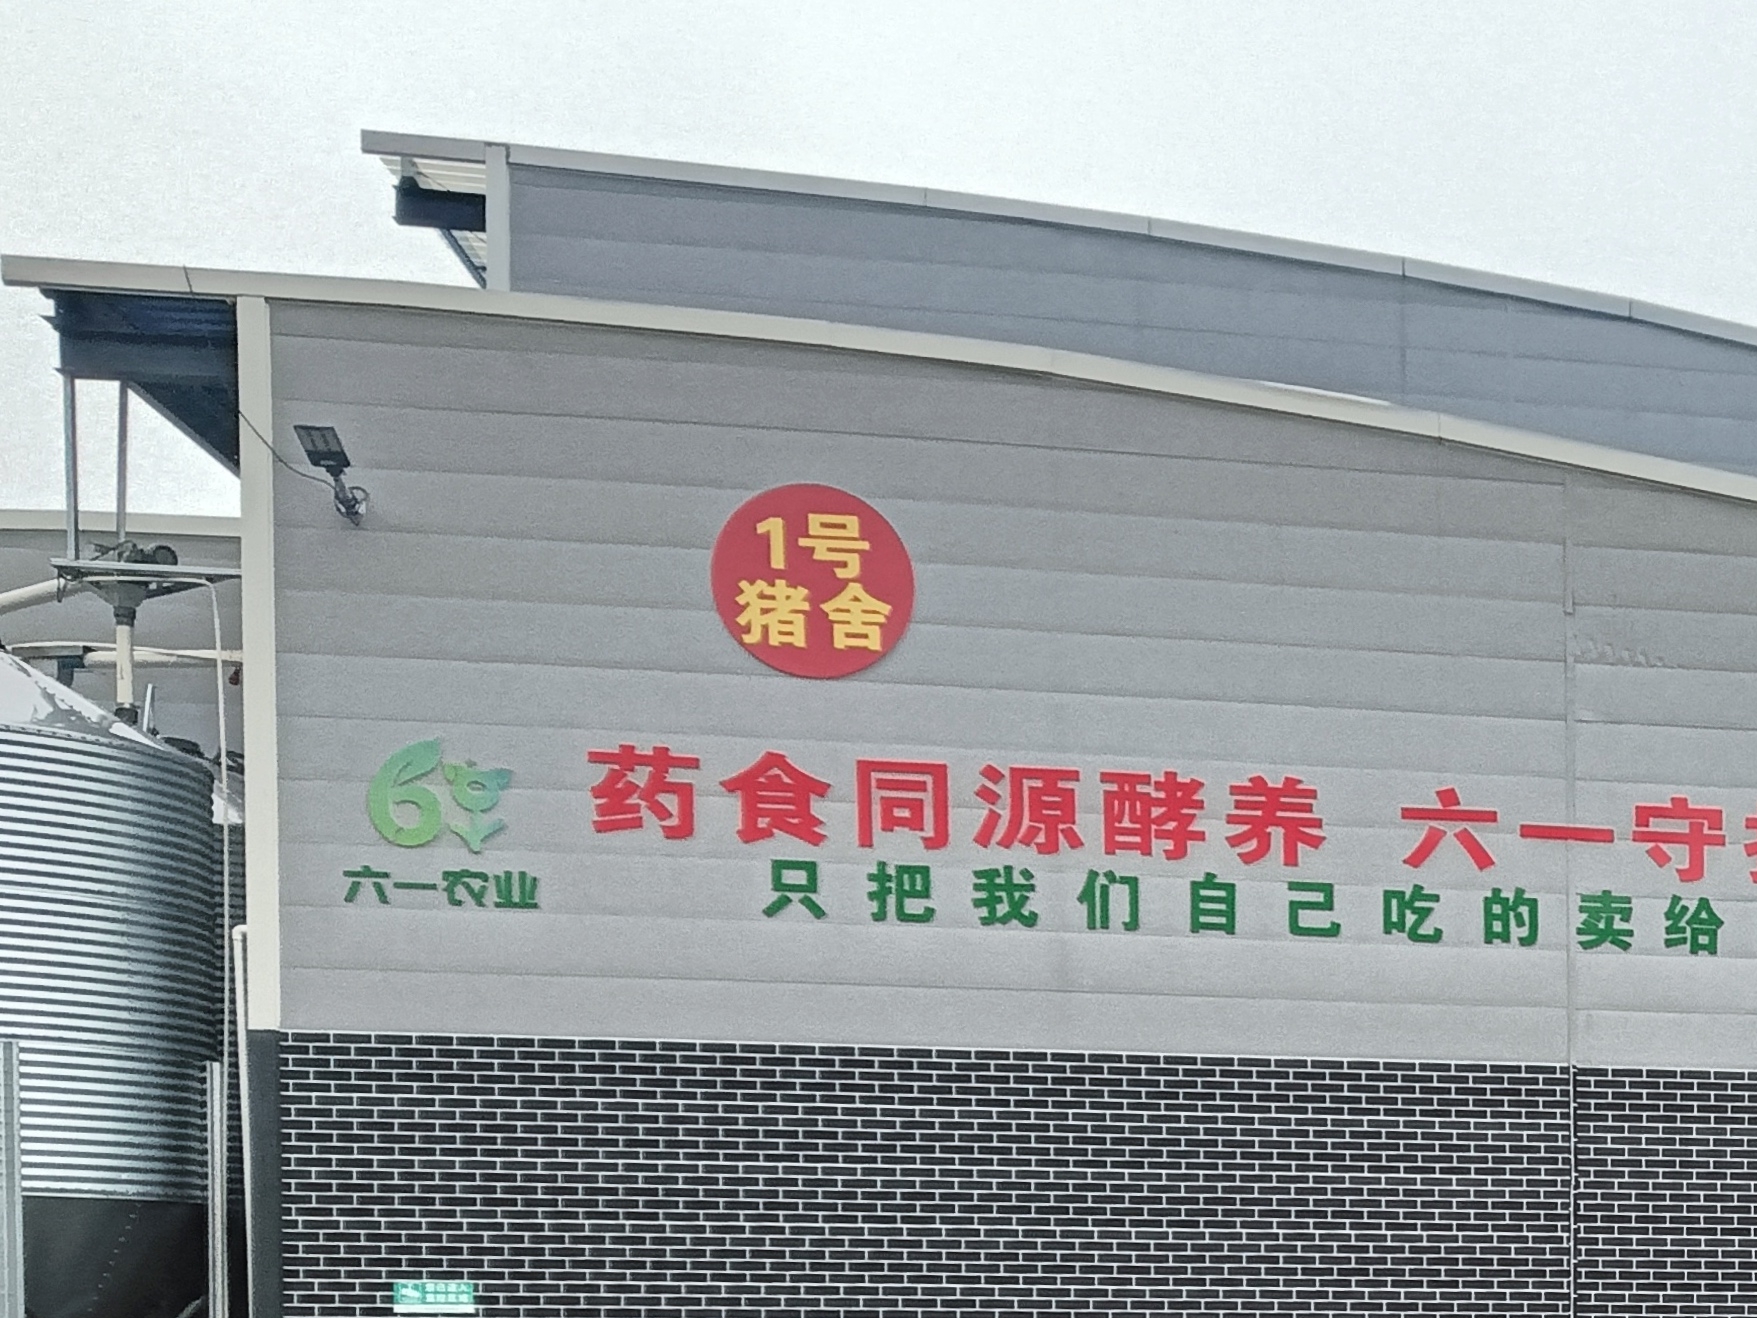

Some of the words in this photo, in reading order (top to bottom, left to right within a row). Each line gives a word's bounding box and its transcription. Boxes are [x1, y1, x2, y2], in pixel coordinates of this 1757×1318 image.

[754, 512, 872, 580] 1号
[733, 578, 894, 653] 猪舍
[587, 743, 1328, 868] 药食同源酵养
[342, 864, 541, 910] 六一农业
